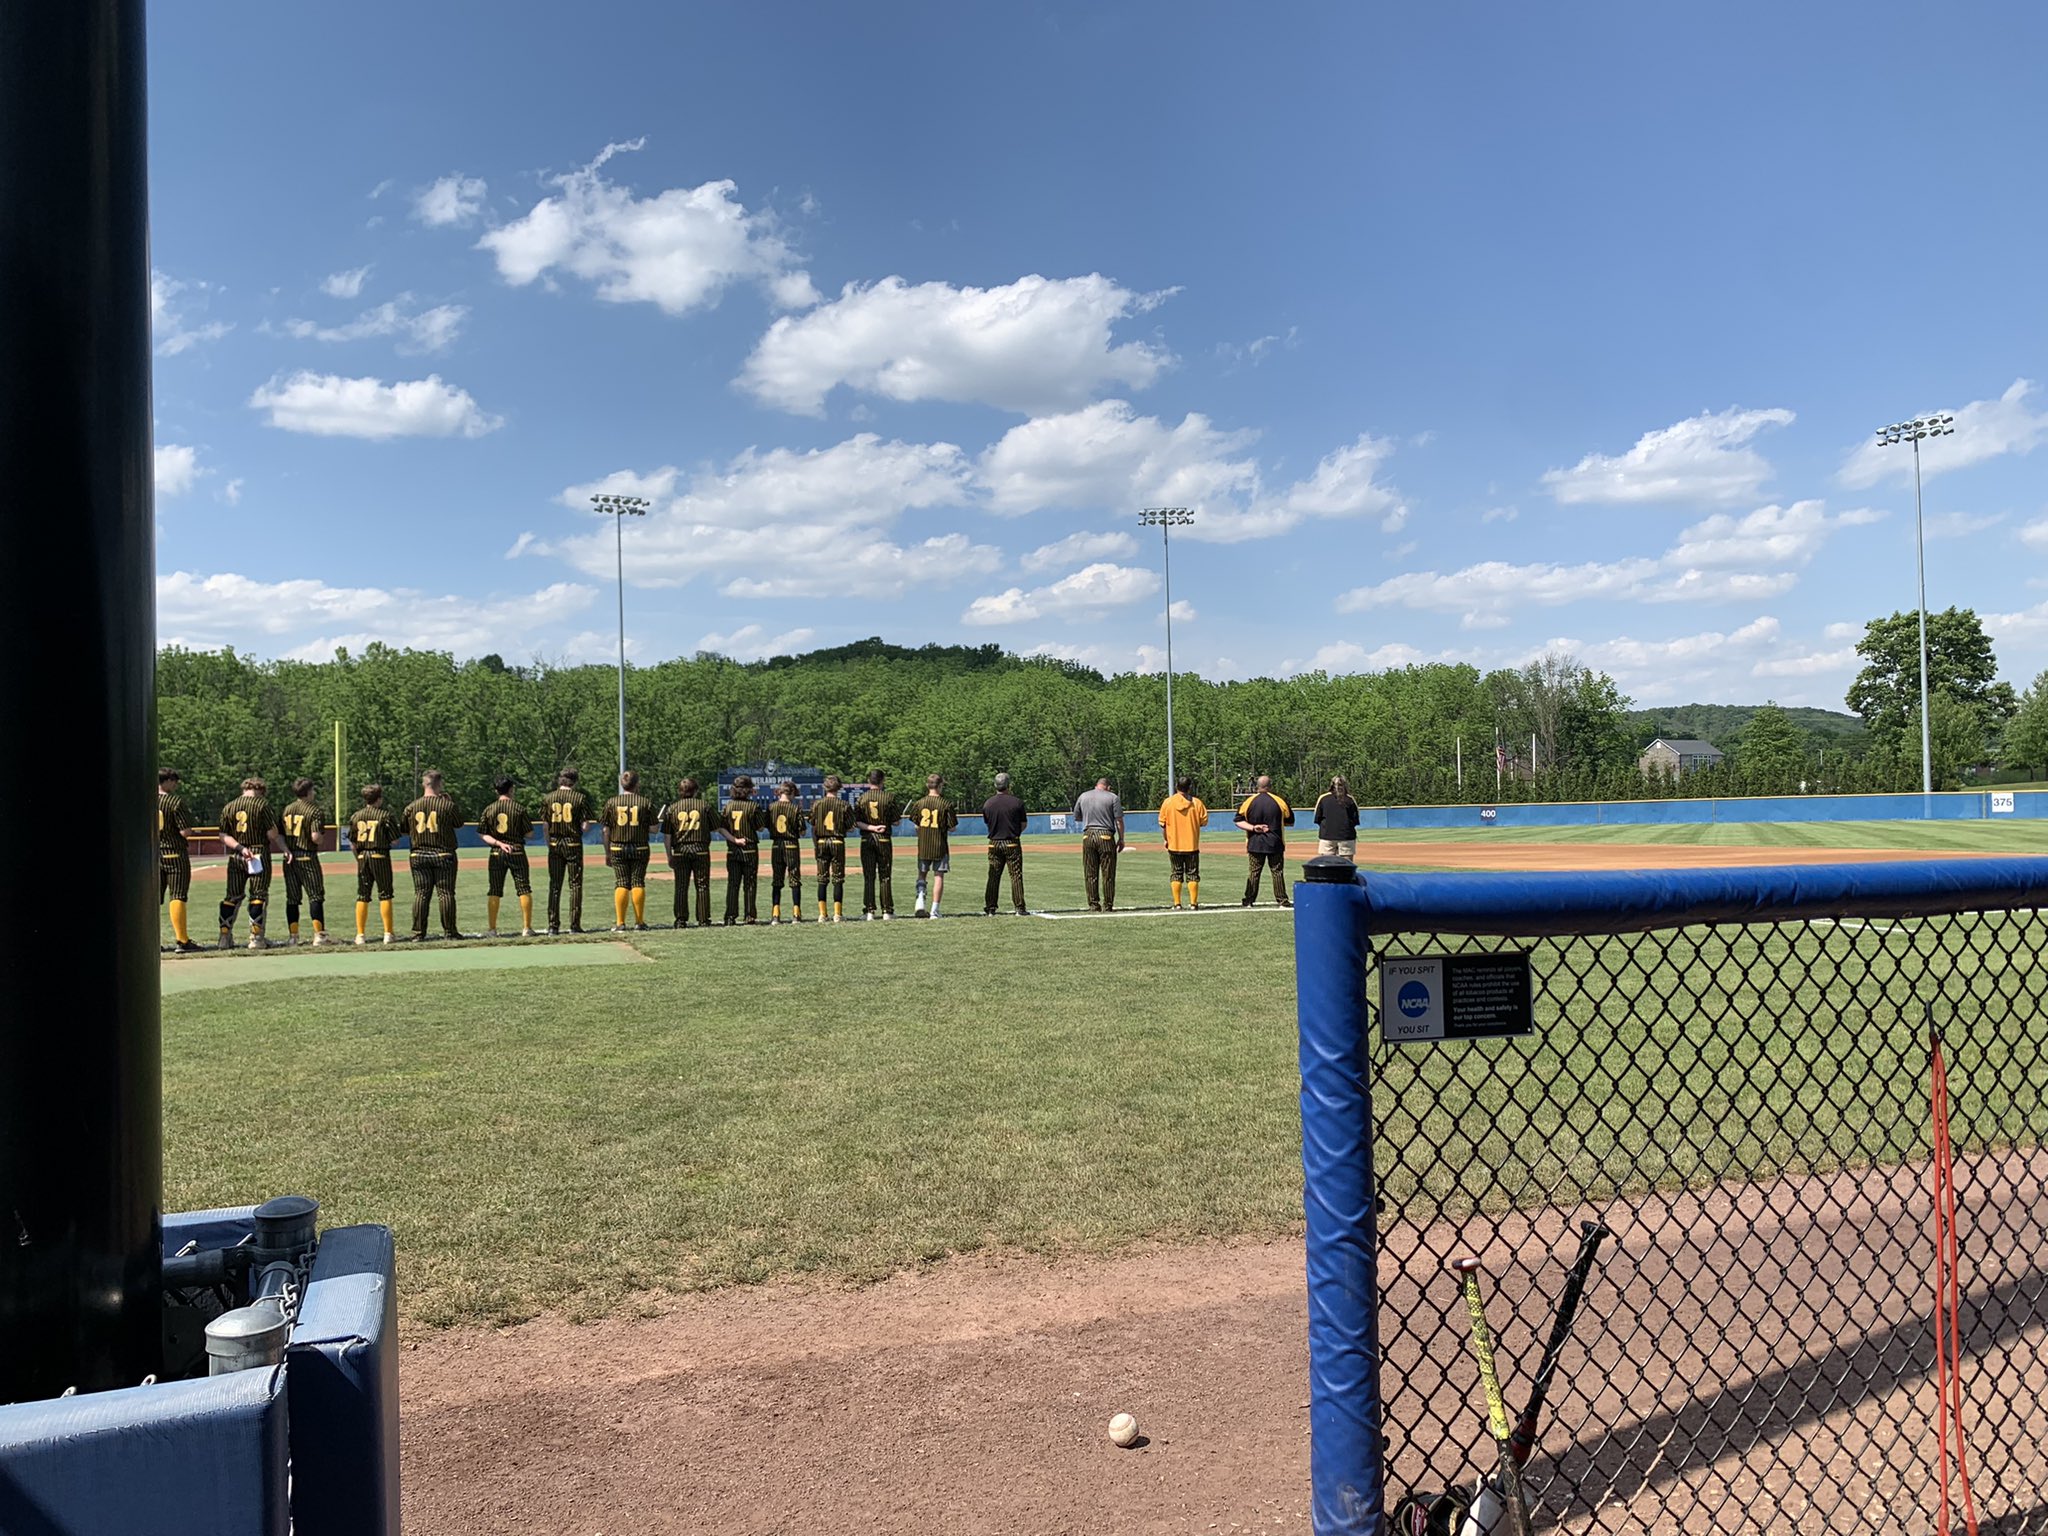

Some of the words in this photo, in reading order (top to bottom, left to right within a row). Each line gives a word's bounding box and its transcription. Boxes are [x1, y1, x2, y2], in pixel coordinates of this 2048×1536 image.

[1993, 798, 2012, 806] 375
[235, 810, 248, 833] 2
[285, 814, 304, 837] 17
[616, 805, 639, 827] 51
[677, 809, 700, 832] 22
[731, 810, 743, 831] 7
[823, 810, 834, 831] 4
[920, 807, 939, 829] 21
[356, 820, 379, 842] 27
[1388, 967, 1397, 976] IF
[1398, 966, 1415, 975] YOU
[1417, 965, 1435, 974] SPIT
[1401, 998, 1431, 1009] NCAA
[1397, 1026, 1415, 1035] YOU
[1416, 1024, 1430, 1033] SIT
